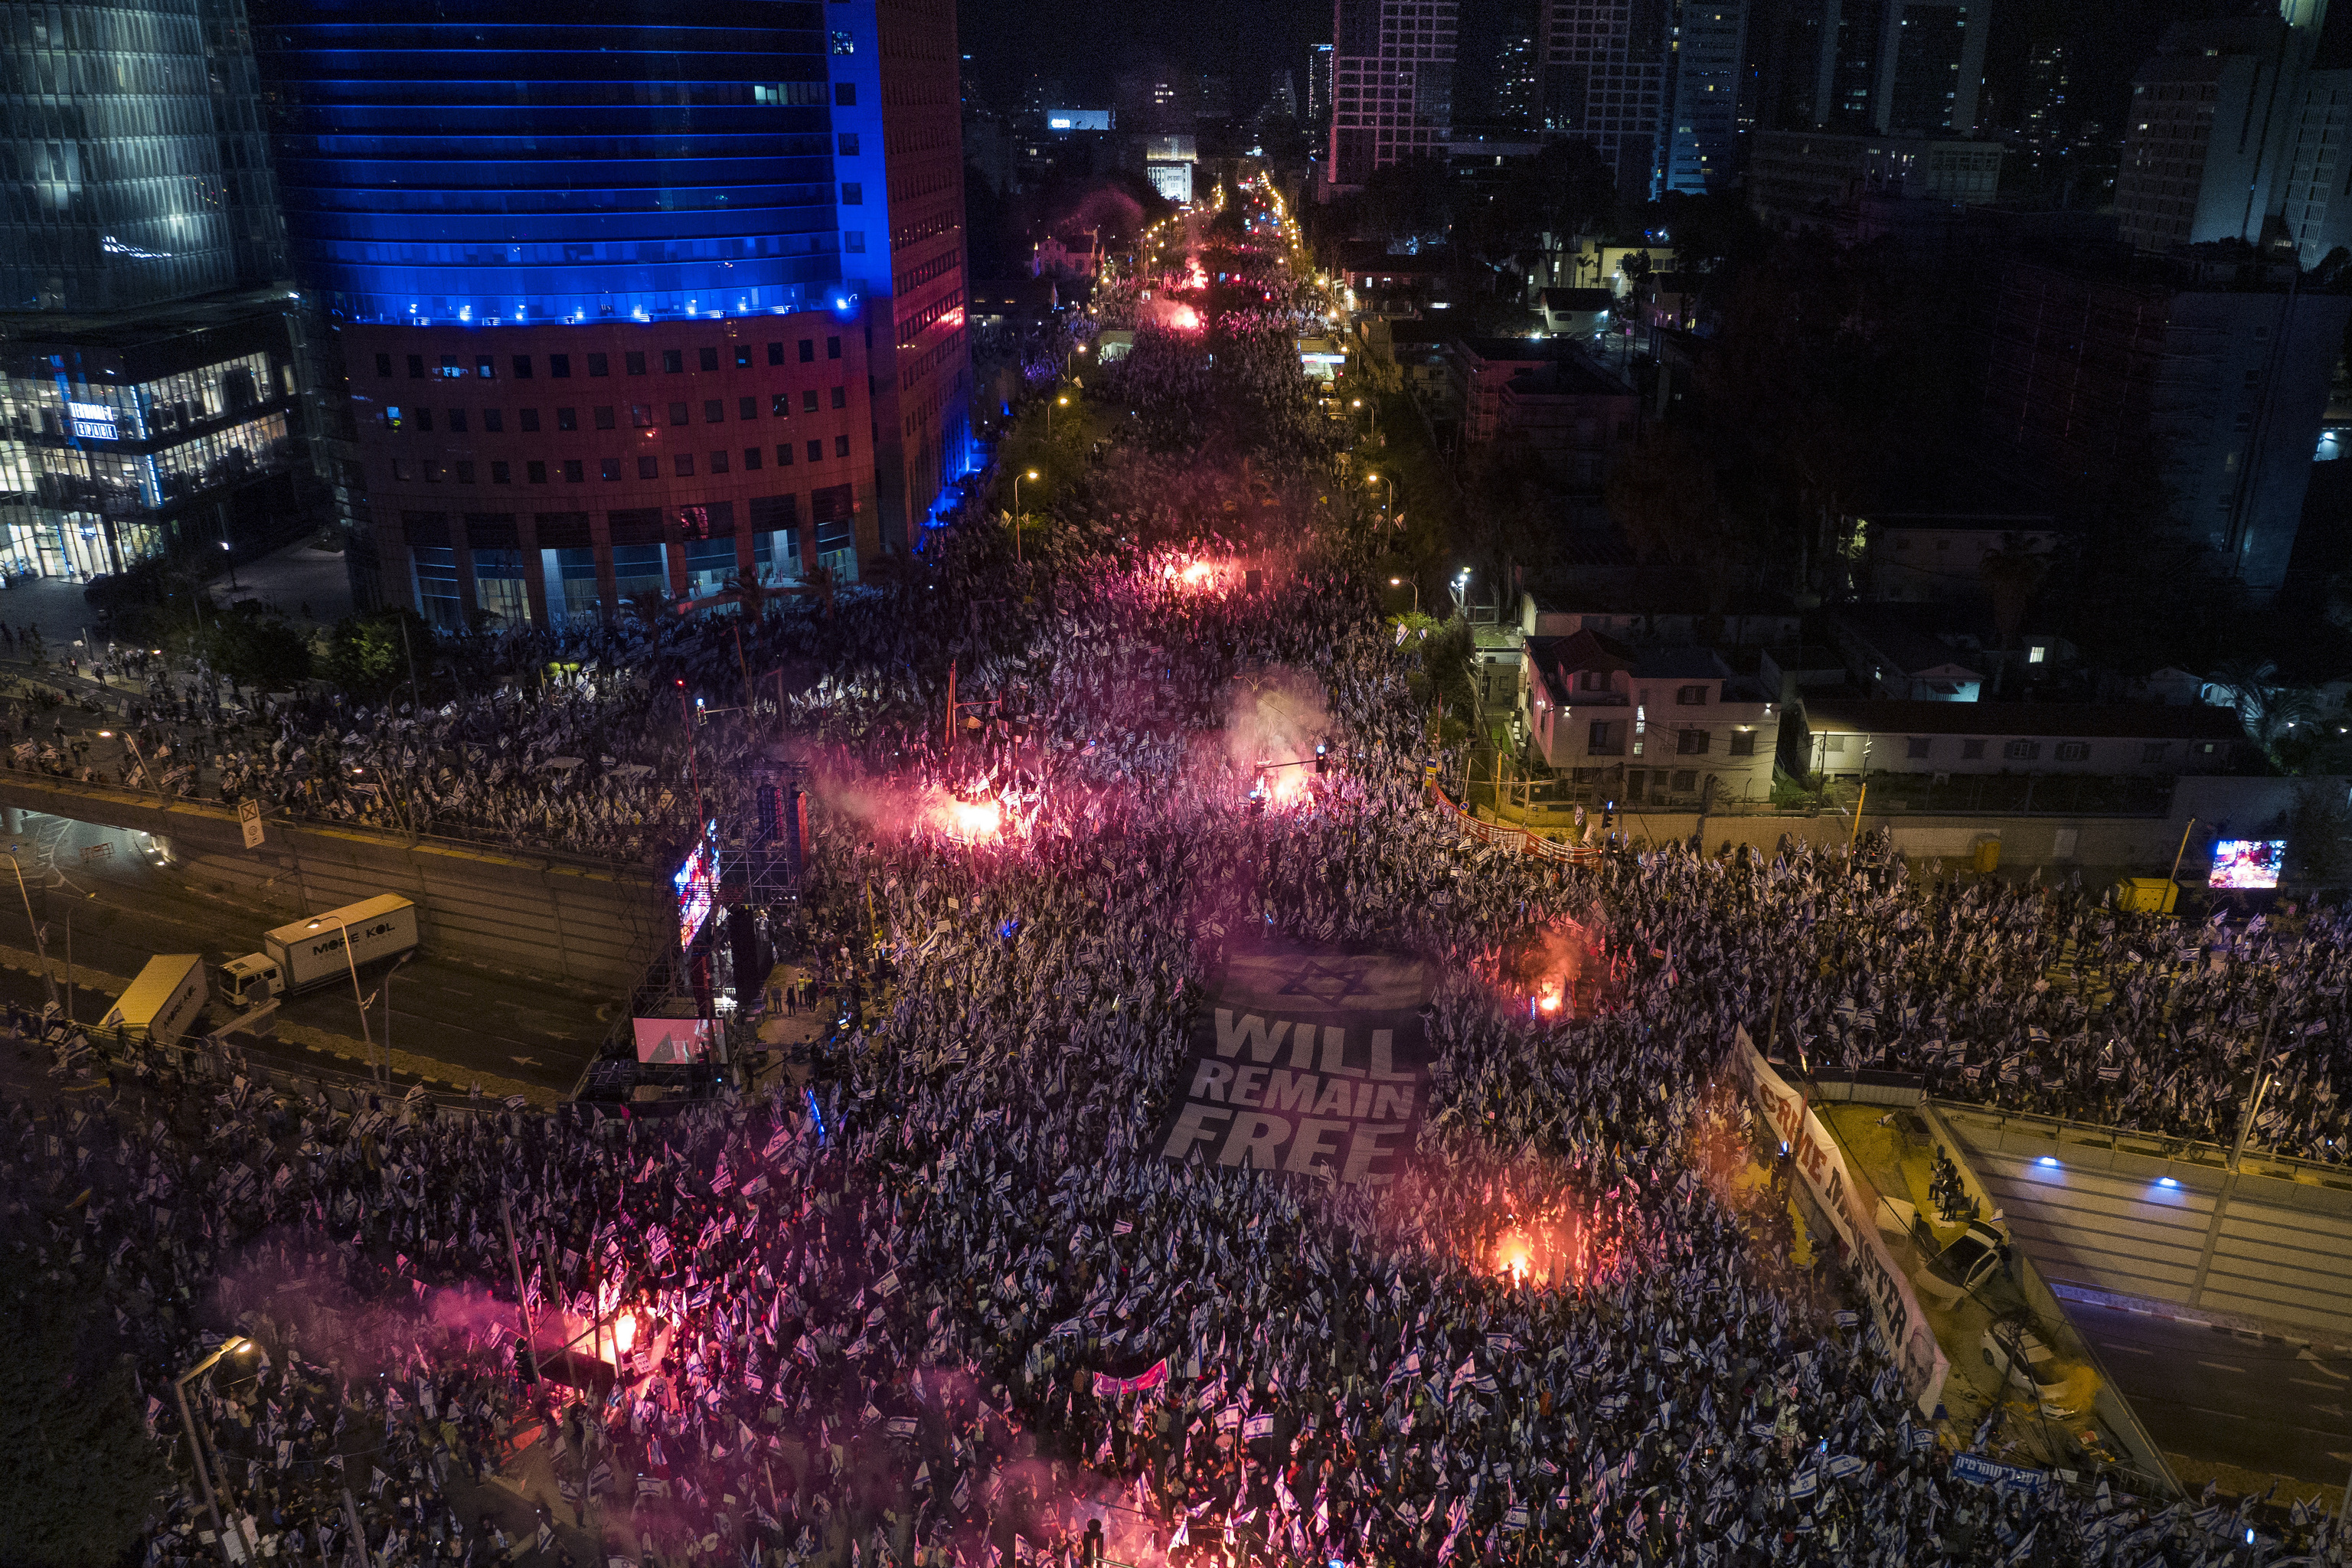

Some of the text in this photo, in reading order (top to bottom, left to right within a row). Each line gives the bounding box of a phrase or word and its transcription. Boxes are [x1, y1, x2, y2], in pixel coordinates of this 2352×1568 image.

[312, 922, 396, 956] MORE KOL
[1214, 1007, 1416, 1082] WILL
[1188, 1058, 1416, 1120] REMAIN
[1164, 1102, 1406, 1187] FREE
[1759, 1083, 1828, 1186] CRIME
